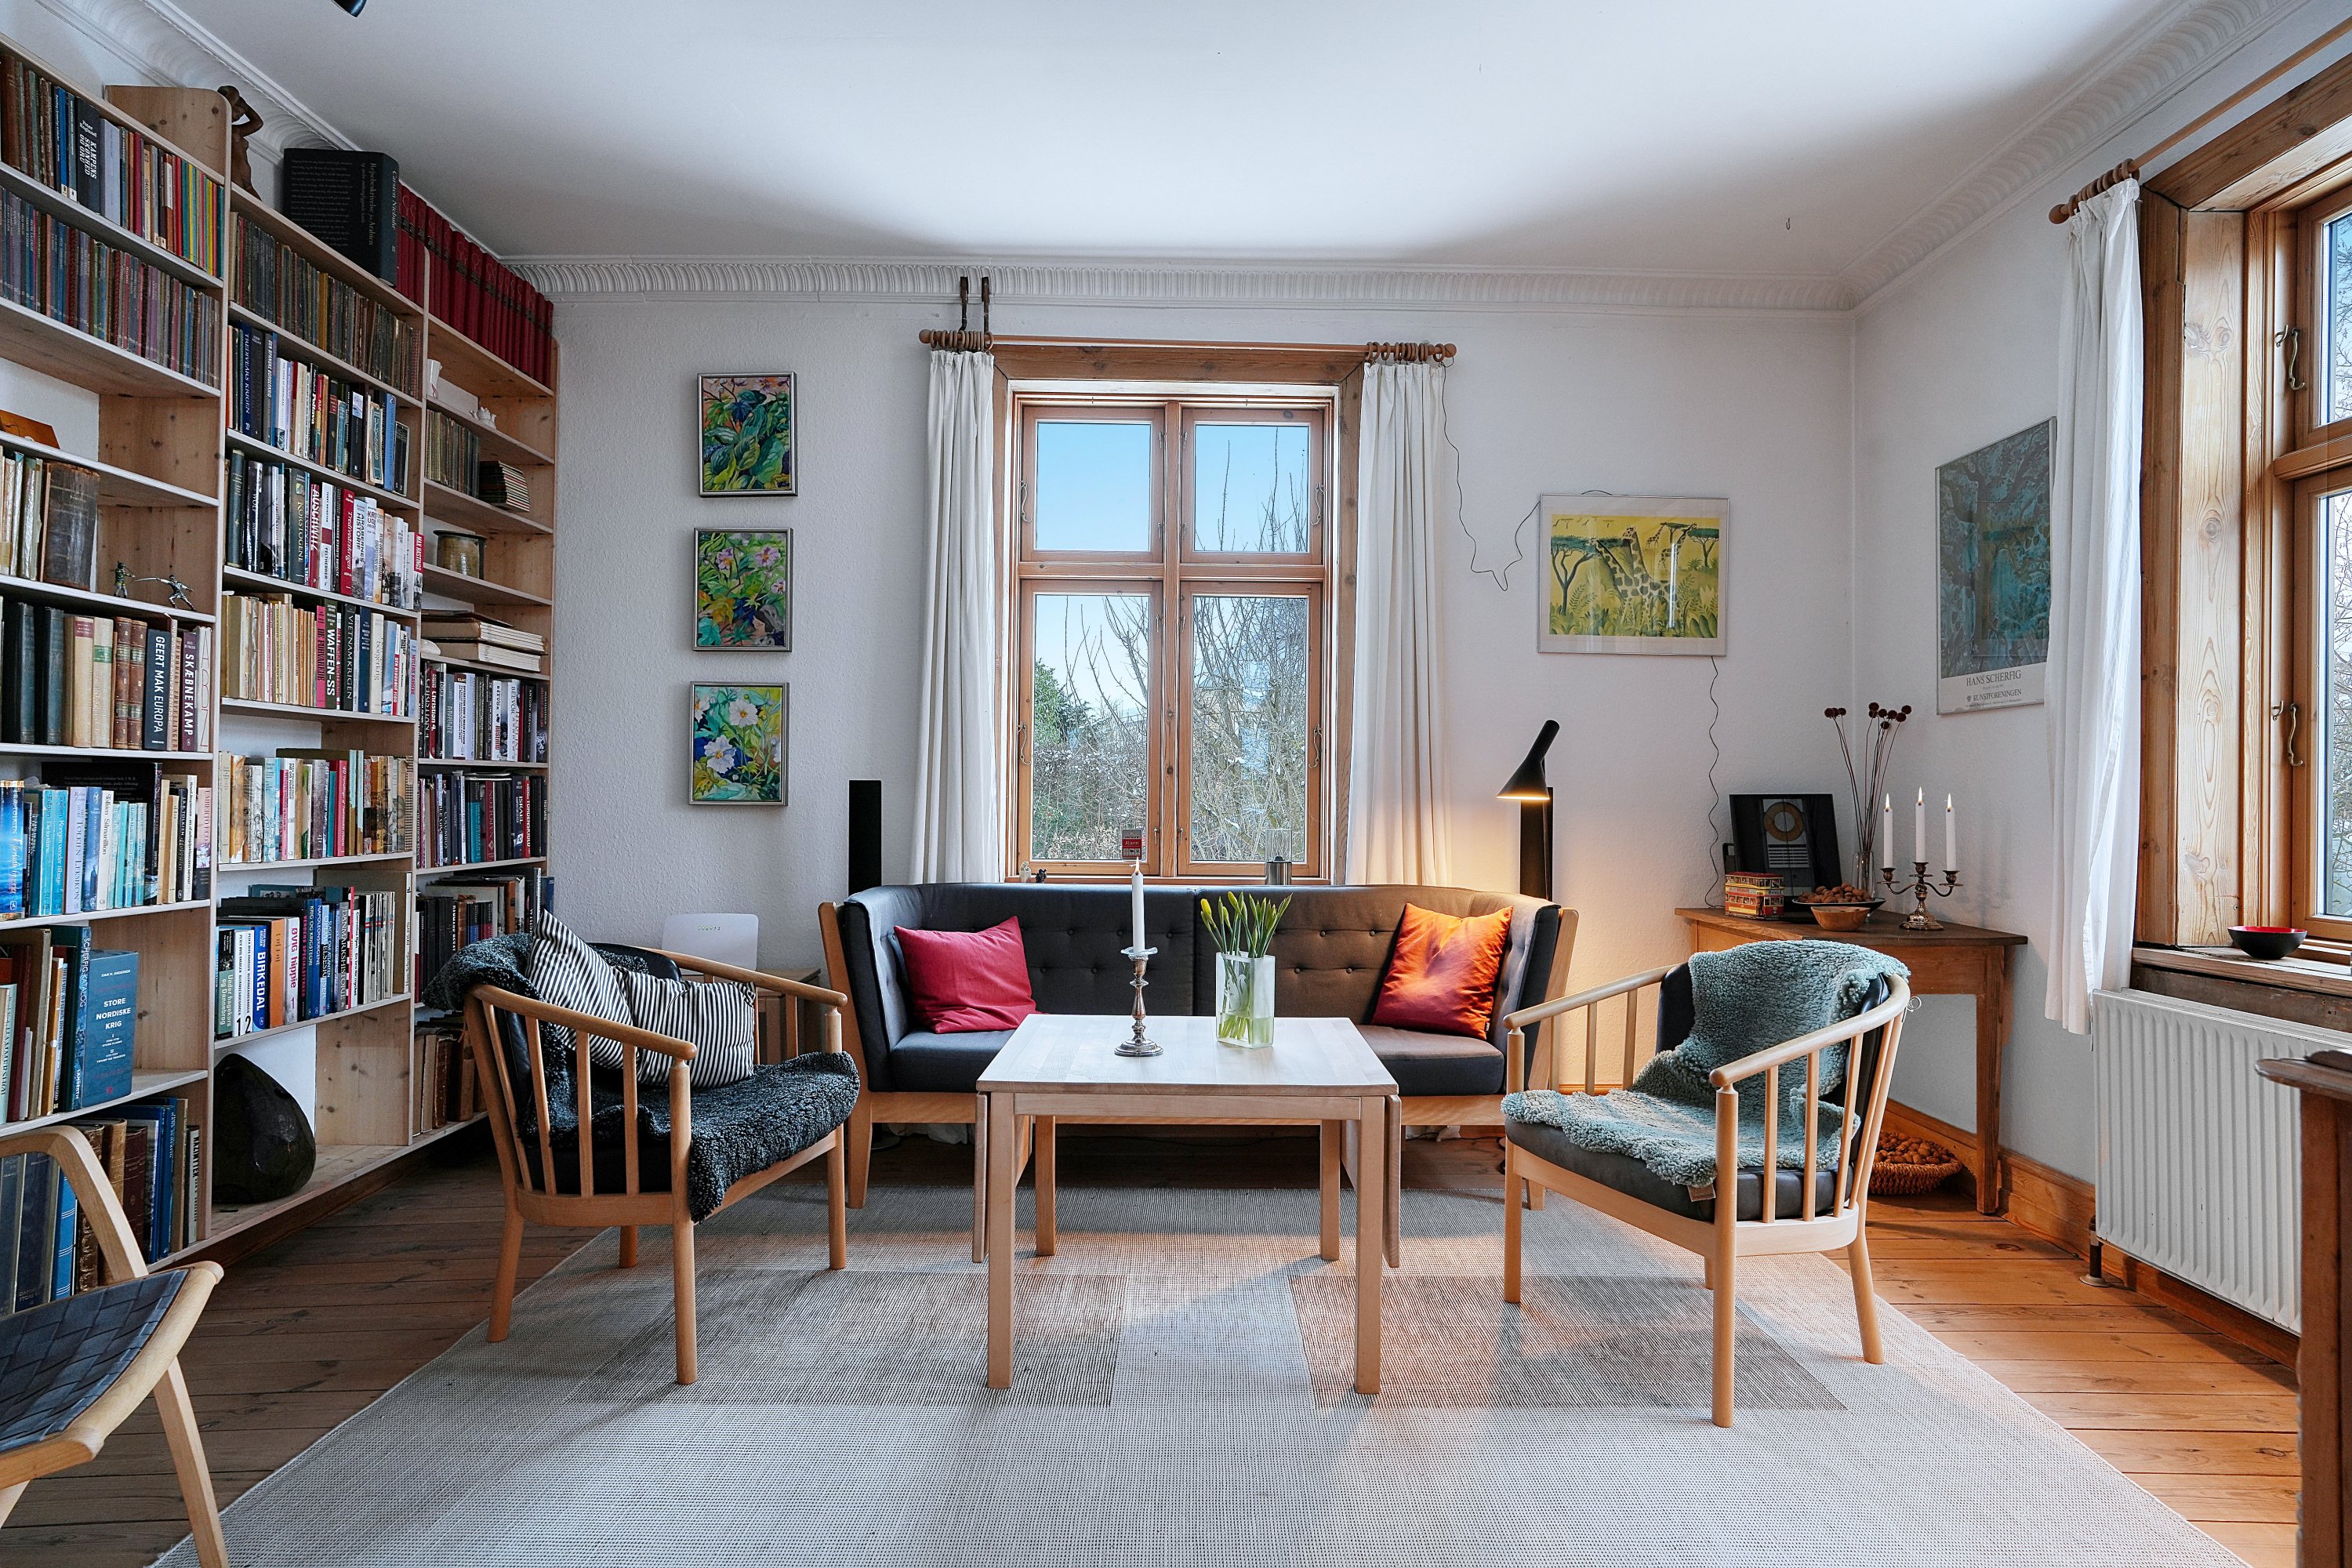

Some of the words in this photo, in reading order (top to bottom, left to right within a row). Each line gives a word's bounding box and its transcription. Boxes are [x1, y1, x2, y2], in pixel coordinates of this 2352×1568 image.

[368, 162, 377, 212] Rejsebeskrivelse
[310, 489, 320, 551] AUSCHWITZ
[318, 628, 325, 638] DE
[155, 636, 165, 667] GEERT
[326, 629, 335, 696] WAFFEN-SS
[154, 670, 164, 692] MAK
[1966, 676, 1984, 686] HANS
[1986, 670, 2021, 683] SCHERFIG
[183, 654, 194, 735] SKÆBNEKAMP
[1973, 689, 2022, 701] KUNSTFORENINGEN
[154, 695, 164, 733] EUROPA
[102, 818, 111, 855] Silmarillion
[309, 920, 314, 931] OG
[82, 938, 90, 973] SCHERFIG
[328, 942, 332, 950] OM
[79, 973, 89, 1007] KATALOG
[256, 952, 267, 1011] BIRKEDAL
[96, 1007, 132, 1021] NORDISKE
[103, 997, 126, 1008] STORE
[105, 1021, 122, 1030] KRIG
